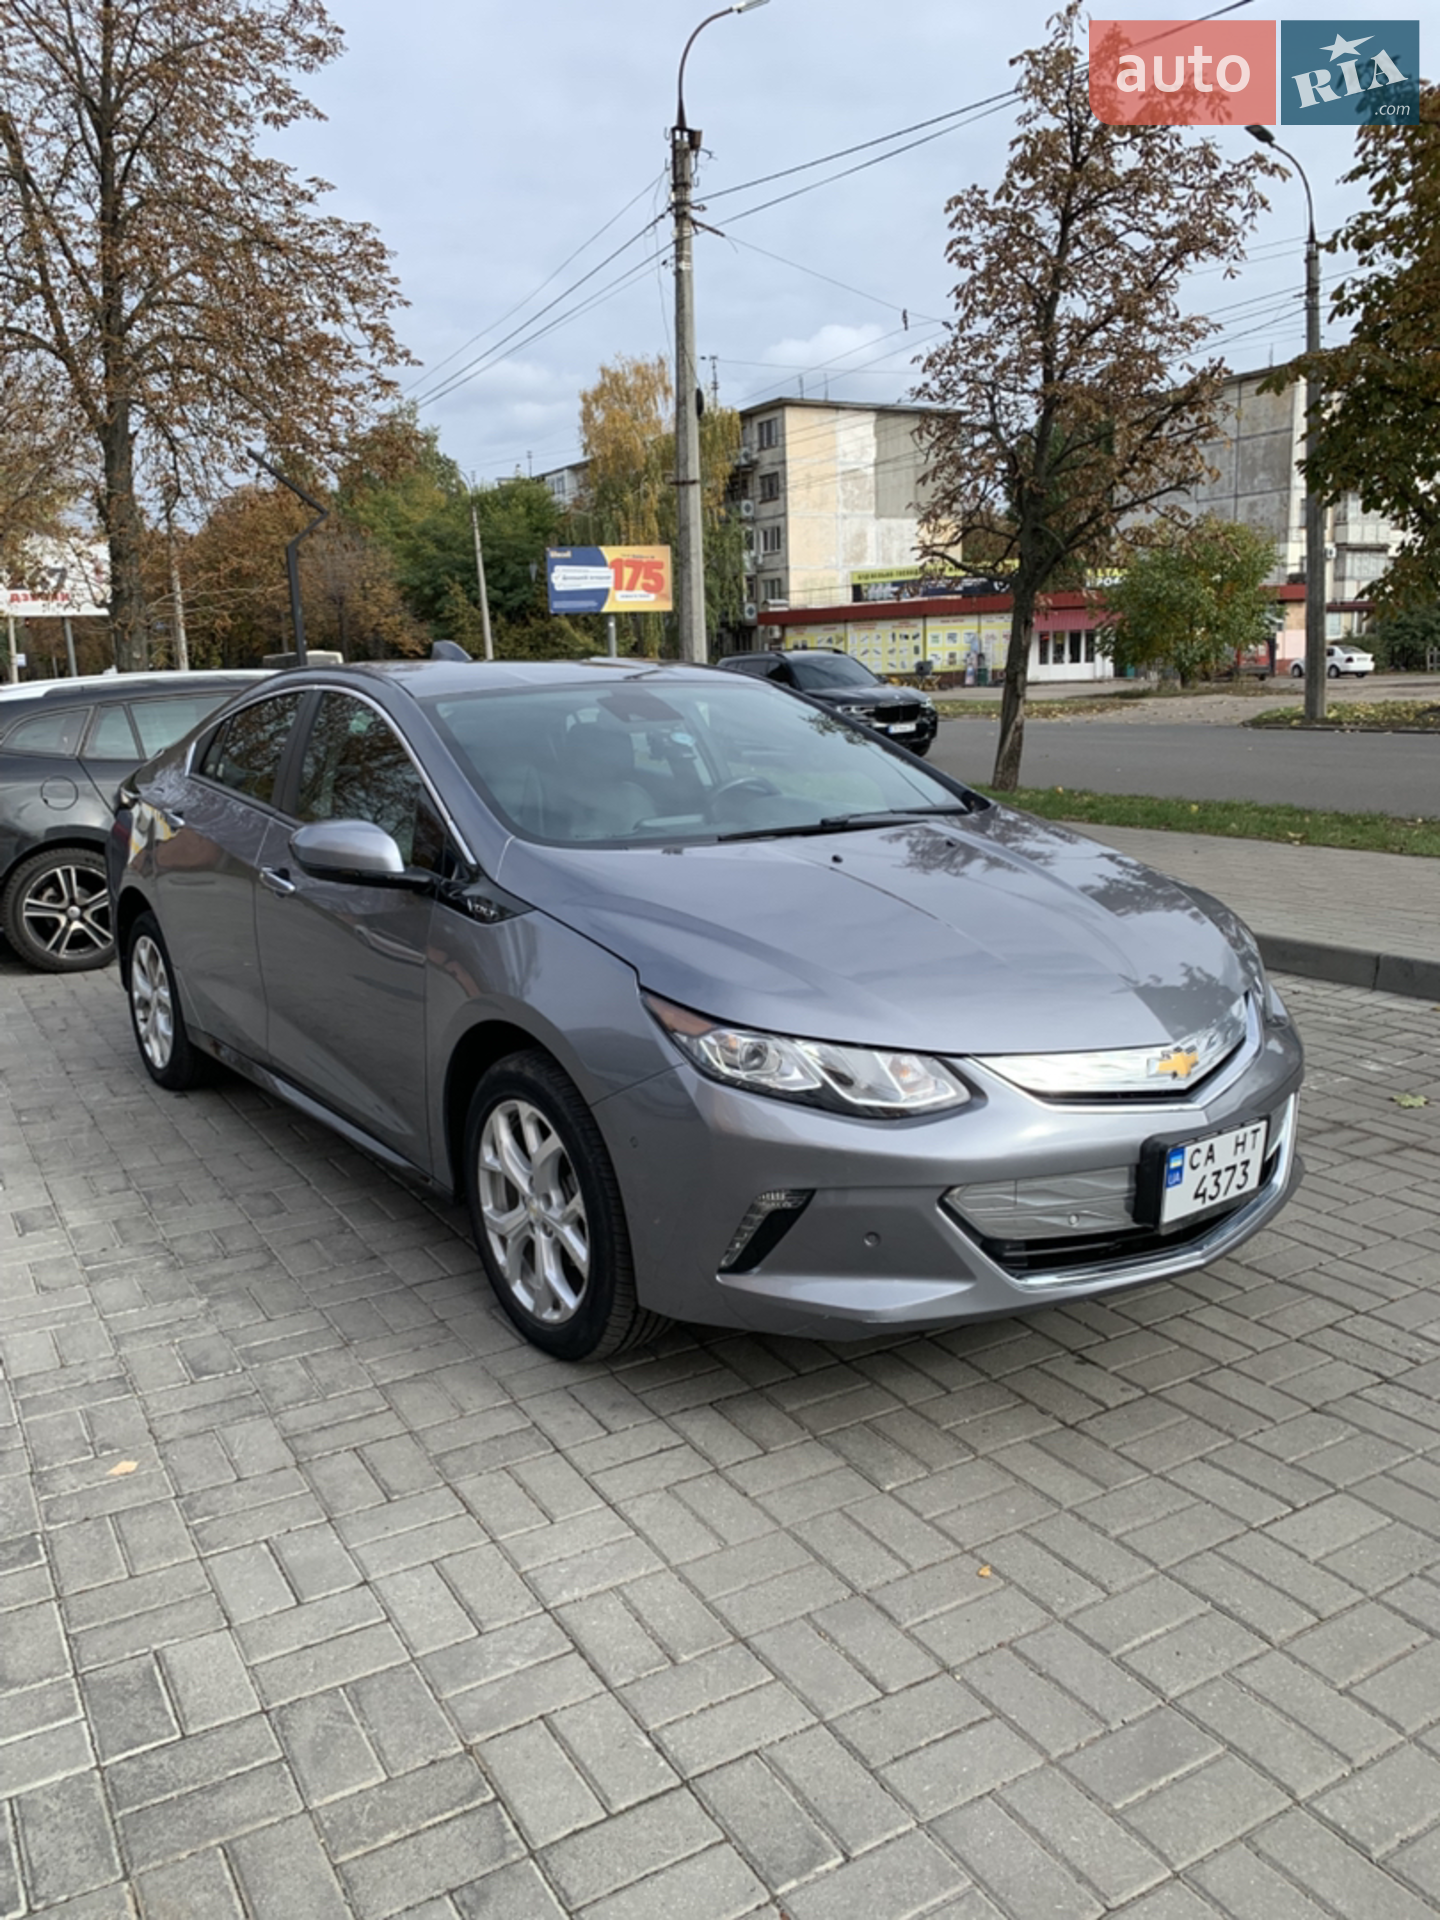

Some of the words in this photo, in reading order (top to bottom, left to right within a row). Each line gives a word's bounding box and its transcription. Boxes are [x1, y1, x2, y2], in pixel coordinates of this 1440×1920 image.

[610, 558, 665, 594] 175
[1188, 1143, 1215, 1171] CA
[1233, 1127, 1261, 1156] HT
[1193, 1159, 1251, 1204] 4373
